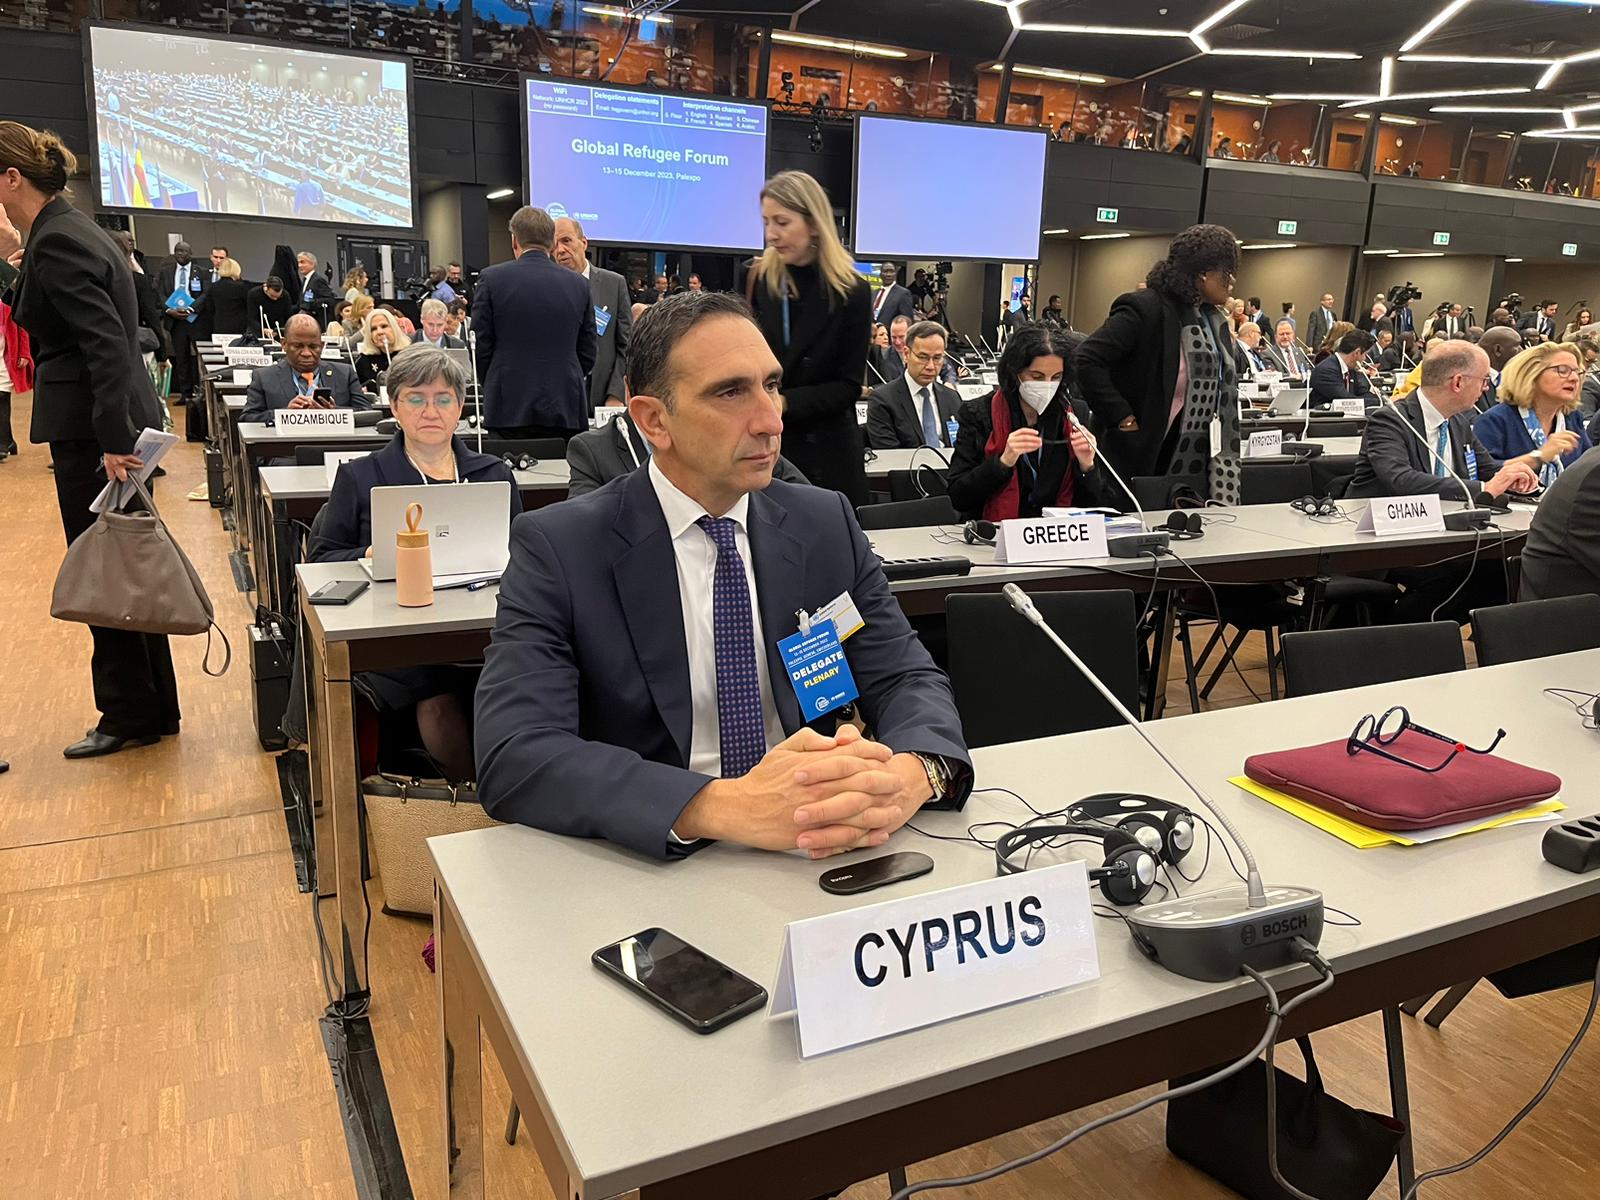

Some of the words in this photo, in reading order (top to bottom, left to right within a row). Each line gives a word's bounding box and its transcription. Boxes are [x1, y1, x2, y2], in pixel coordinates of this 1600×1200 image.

[594, 92, 626, 101] Delegation
[627, 95, 659, 105] statements
[683, 101, 720, 112] Interpretation
[742, 116, 760, 124] Chinese
[572, 138, 618, 156] Global
[623, 143, 681, 163] Refugee
[685, 148, 728, 166] Forum
[624, 168, 656, 178] December
[657, 171, 674, 180] 2023,
[676, 173, 701, 182] Palexpo
[281, 414, 348, 425] MOZAMBIQUE
[1387, 502, 1428, 520] GHANA
[1023, 524, 1089, 544] GREECE
[792, 651, 844, 680] DELEGATE
[804, 666, 839, 689] PLENARY
[1262, 914, 1307, 937] BOSCH
[854, 896, 1046, 987] CYPRUS
